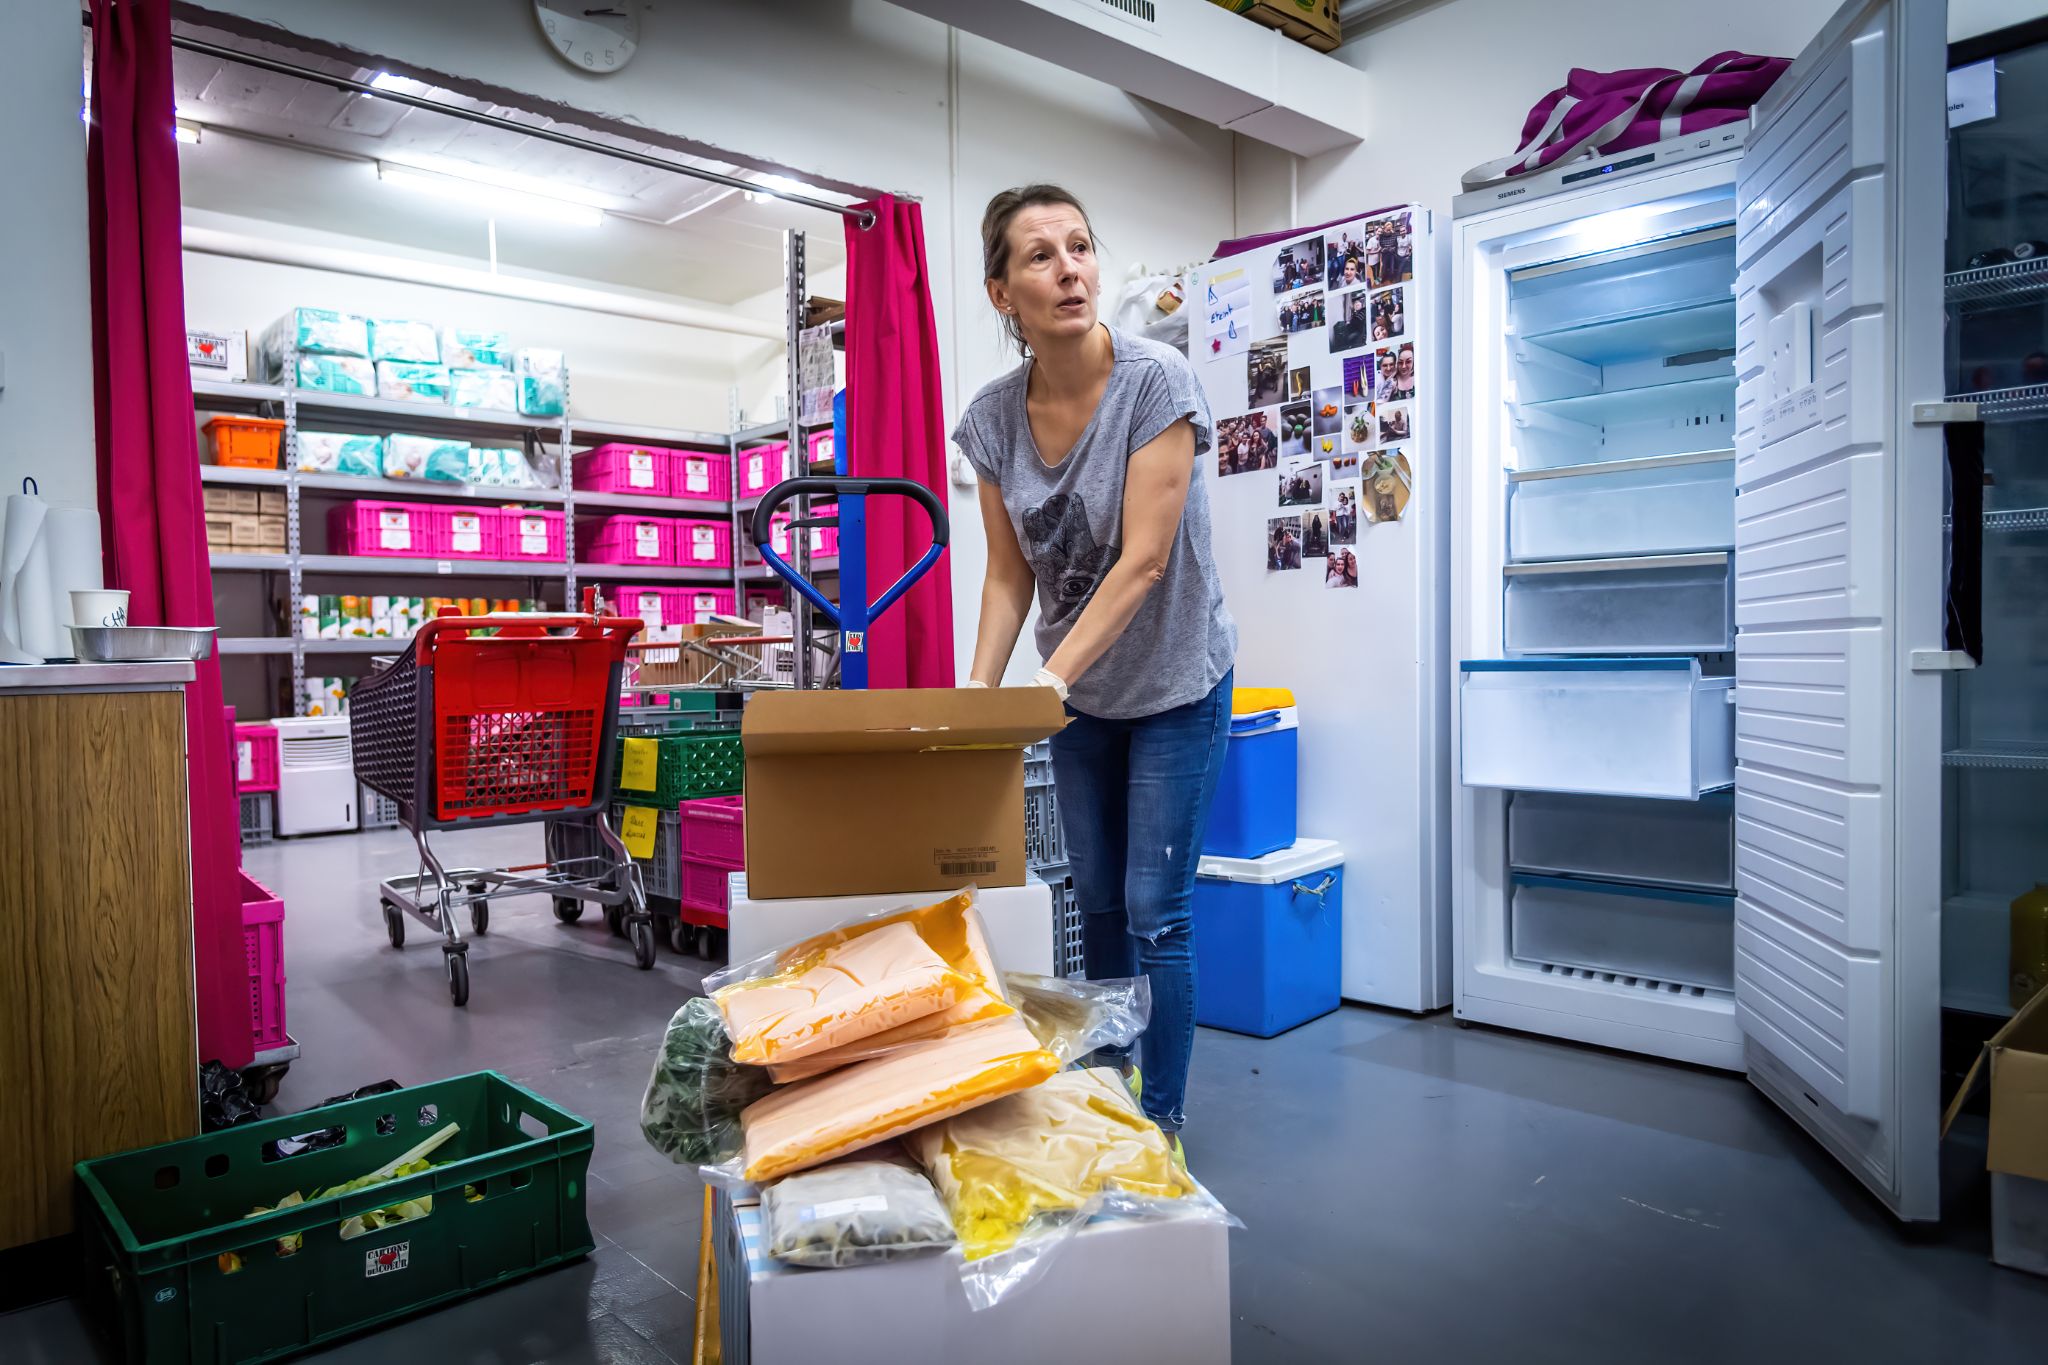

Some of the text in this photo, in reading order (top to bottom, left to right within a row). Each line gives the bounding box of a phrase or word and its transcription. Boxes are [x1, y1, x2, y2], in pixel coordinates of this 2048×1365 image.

[562, 39, 573, 56] 7
[583, 51, 594, 67] 6
[604, 48, 615, 66] 5
[1497, 187, 1526, 200] SIEMENS
[367, 1243, 408, 1260] CARTONS
